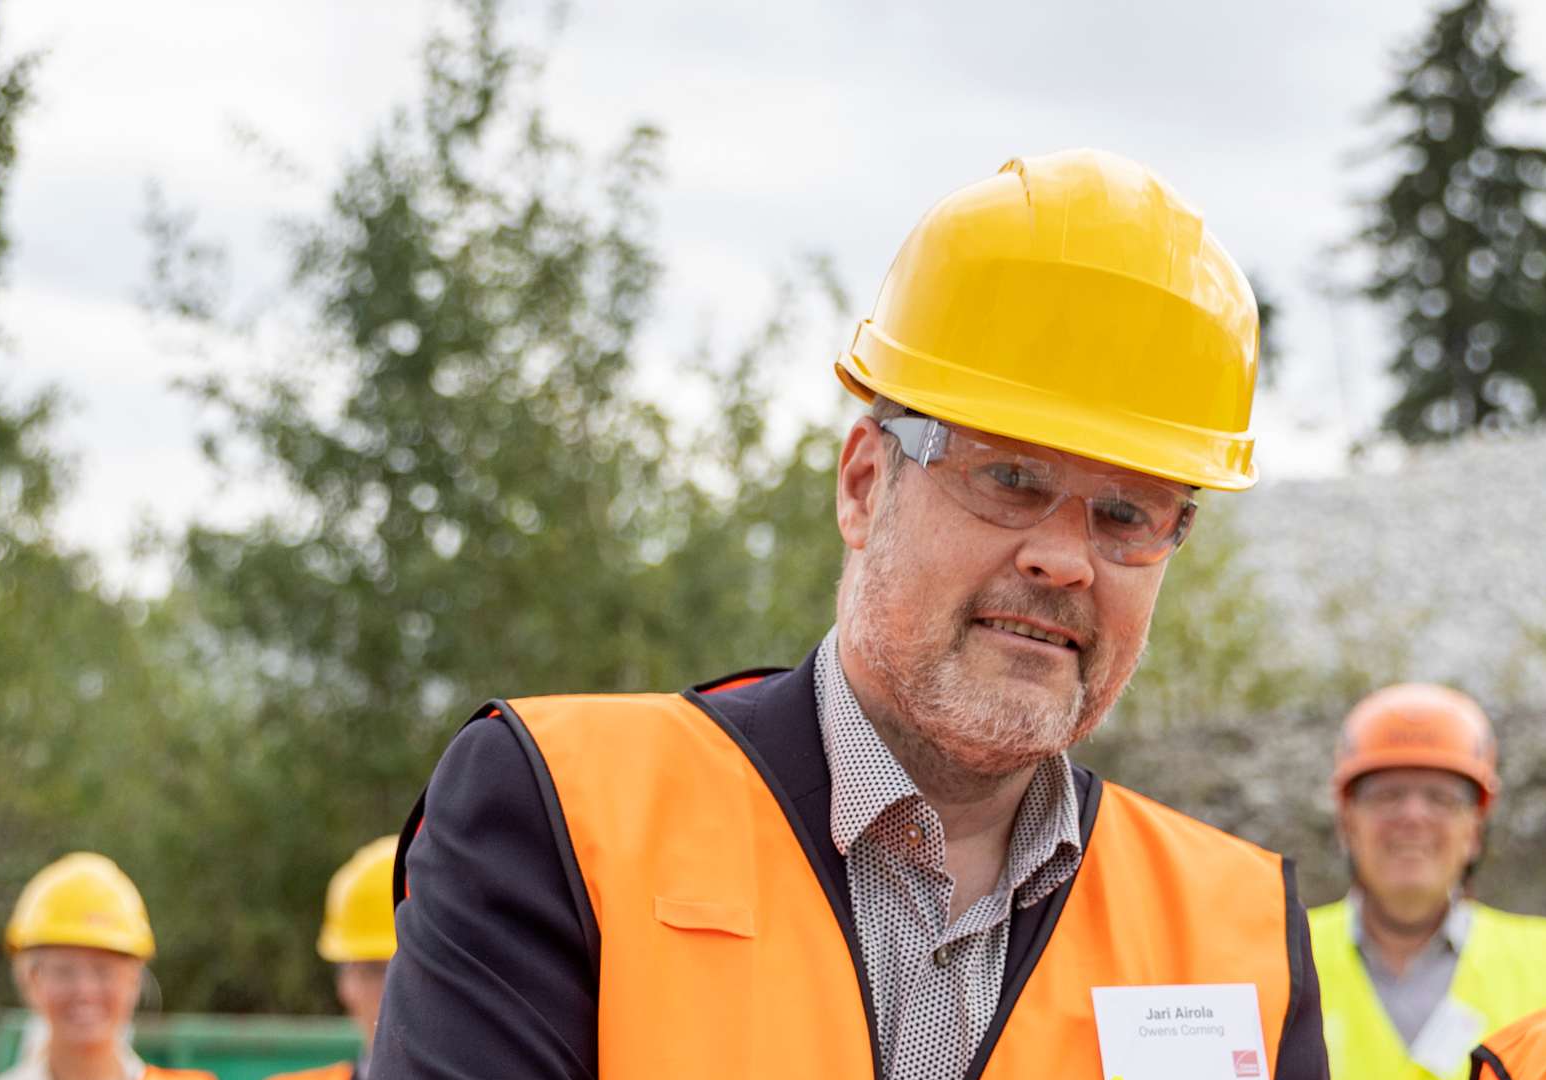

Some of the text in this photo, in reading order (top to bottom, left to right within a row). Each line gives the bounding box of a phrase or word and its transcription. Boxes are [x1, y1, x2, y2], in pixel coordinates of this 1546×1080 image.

[1146, 1006, 1214, 1020] Jari Airola
[1138, 1025, 1178, 1037] Owens
